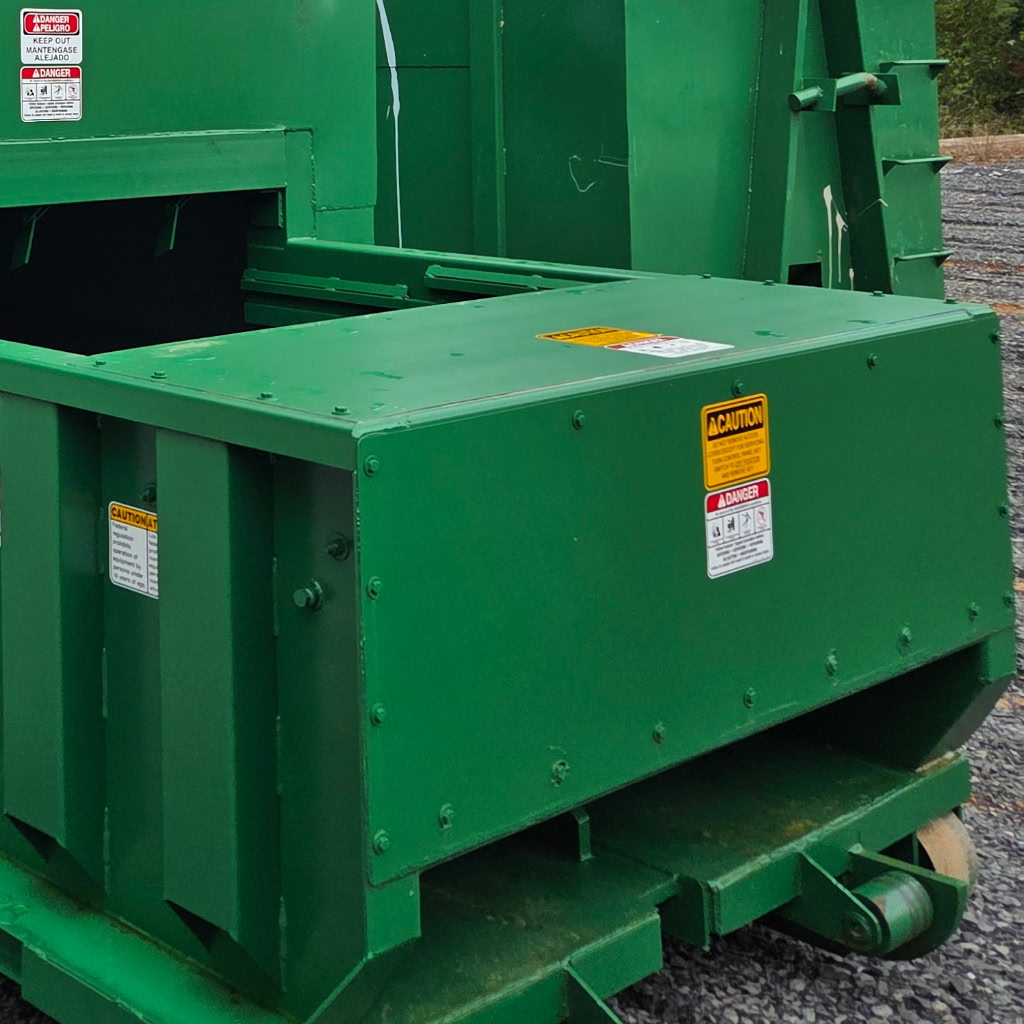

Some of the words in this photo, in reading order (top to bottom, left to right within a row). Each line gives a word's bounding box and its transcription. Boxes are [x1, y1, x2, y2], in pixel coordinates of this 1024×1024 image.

[40, 15, 69, 23] DANGER
[40, 24, 71, 32] PELIGRO
[26, 46, 78, 54] MANTENGASE
[40, 69, 71, 78] DANGER
[717, 405, 762, 434] CAUTION
[726, 484, 759, 506] DANGER
[111, 507, 147, 527] CAUTION
